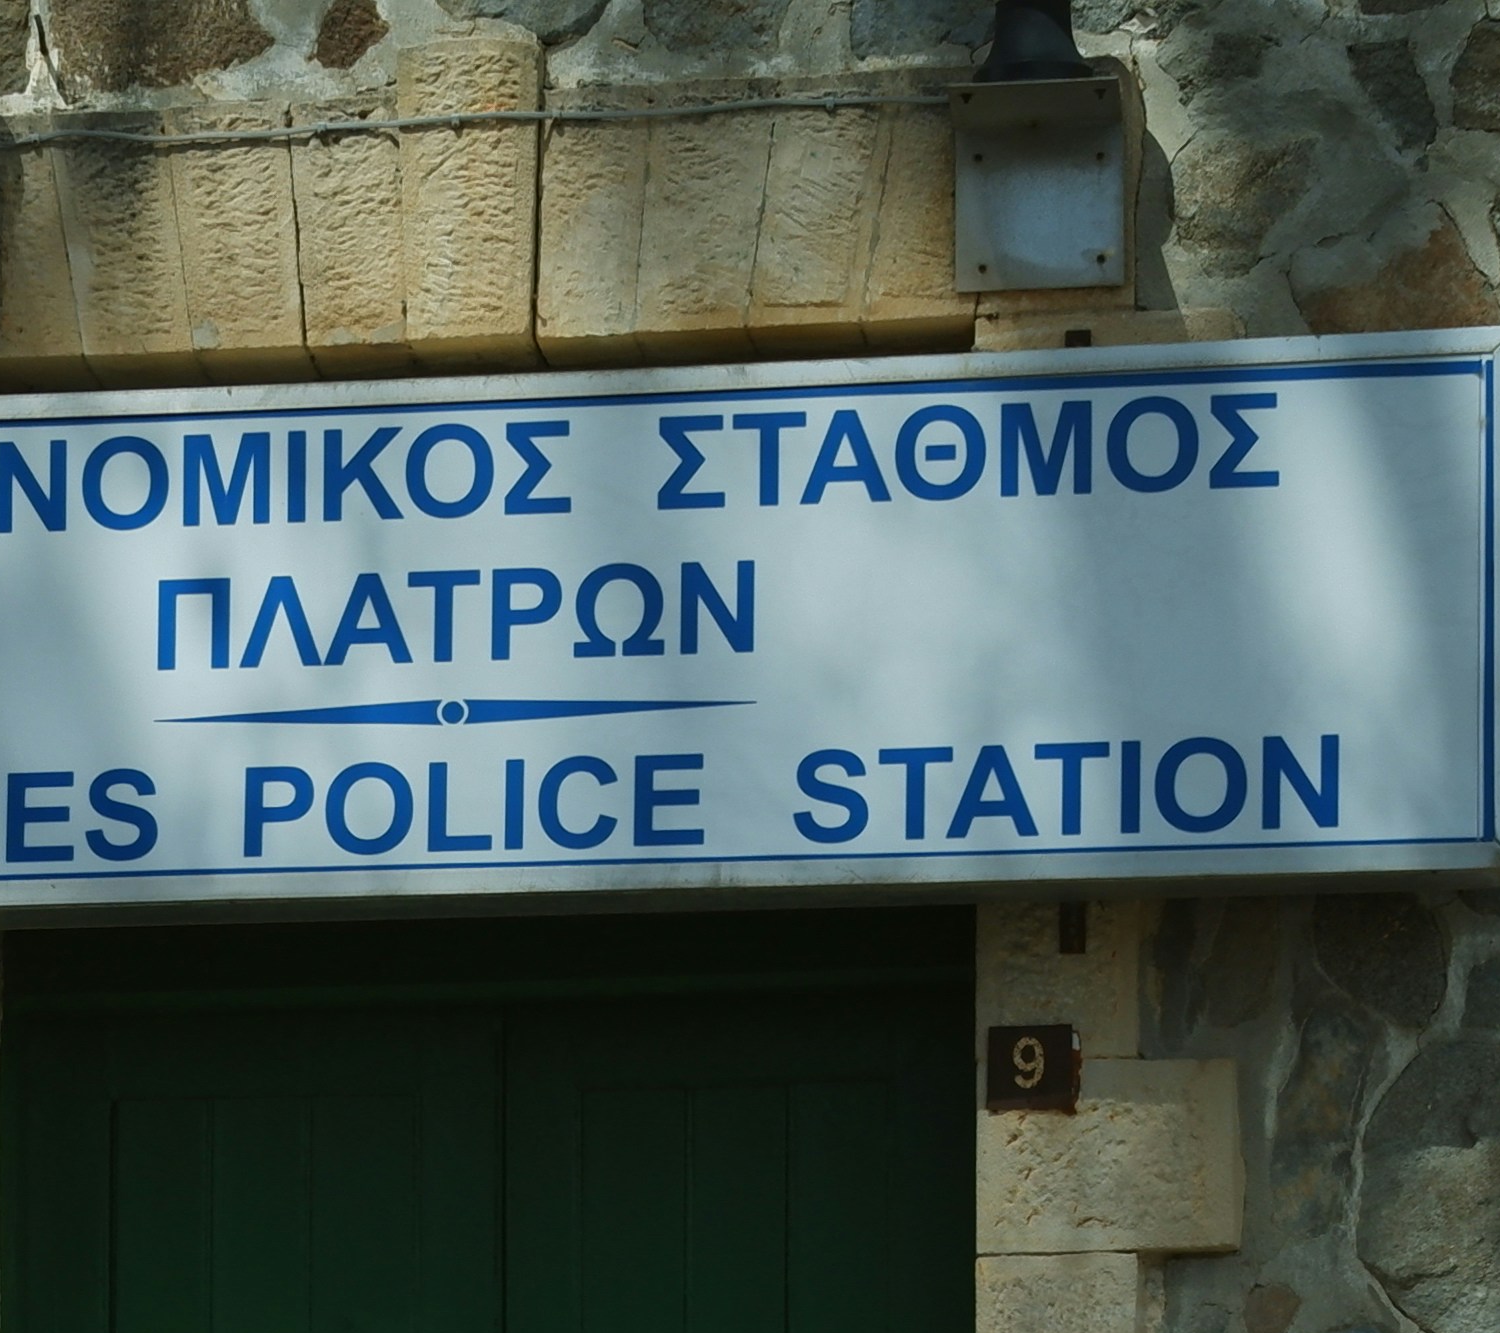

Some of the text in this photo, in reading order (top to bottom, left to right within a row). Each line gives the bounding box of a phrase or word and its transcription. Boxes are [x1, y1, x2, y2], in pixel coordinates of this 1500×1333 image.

[658, 393, 1279, 509] ΣΤΑΘΜΟΣ
[158, 561, 754, 670] ΠΛΑΤΡΩΝ
[244, 754, 704, 857] POLICE
[793, 735, 1339, 843] STATION
[1013, 1036, 1045, 1089] 9
